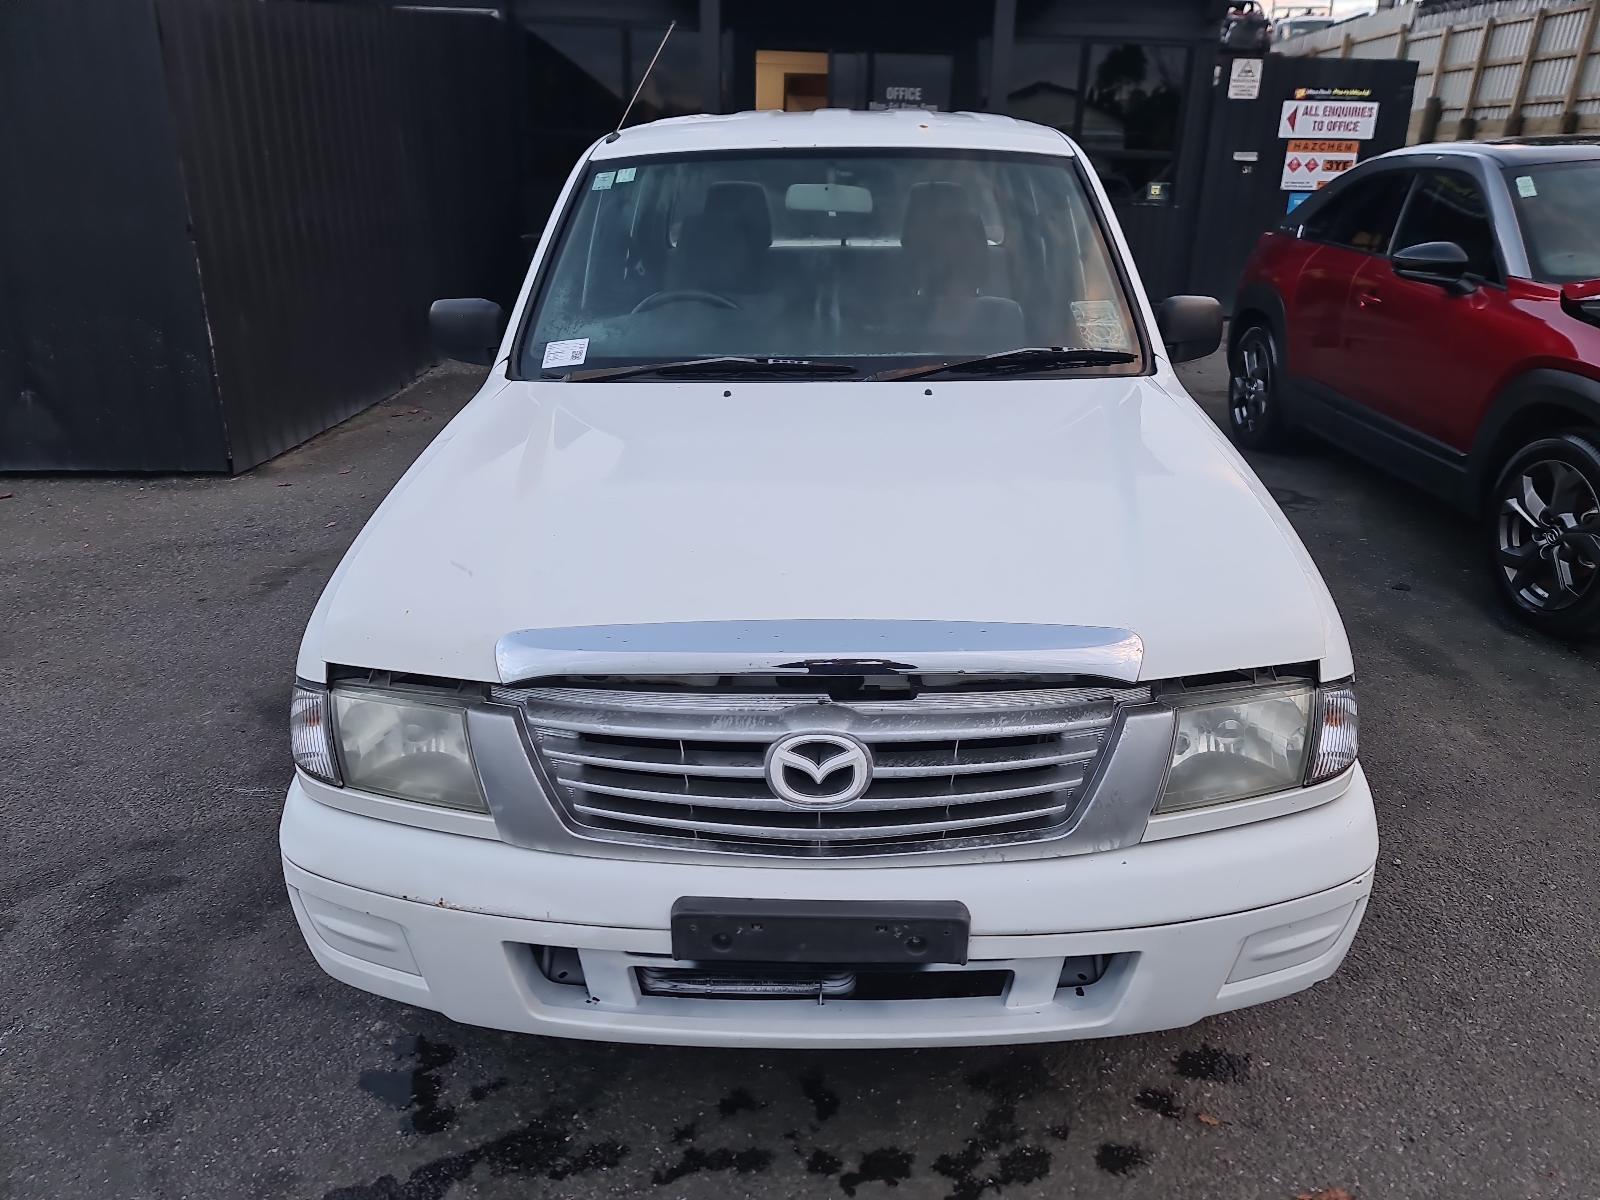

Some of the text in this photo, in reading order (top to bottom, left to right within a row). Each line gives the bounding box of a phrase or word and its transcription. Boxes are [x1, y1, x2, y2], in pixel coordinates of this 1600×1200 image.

[886, 87, 922, 100] OFFICE
[1302, 105, 1374, 118] ALL ENQUIRIES
[1312, 120, 1361, 132] TO OFFICE
[1294, 142, 1353, 151] HAZCHEM
